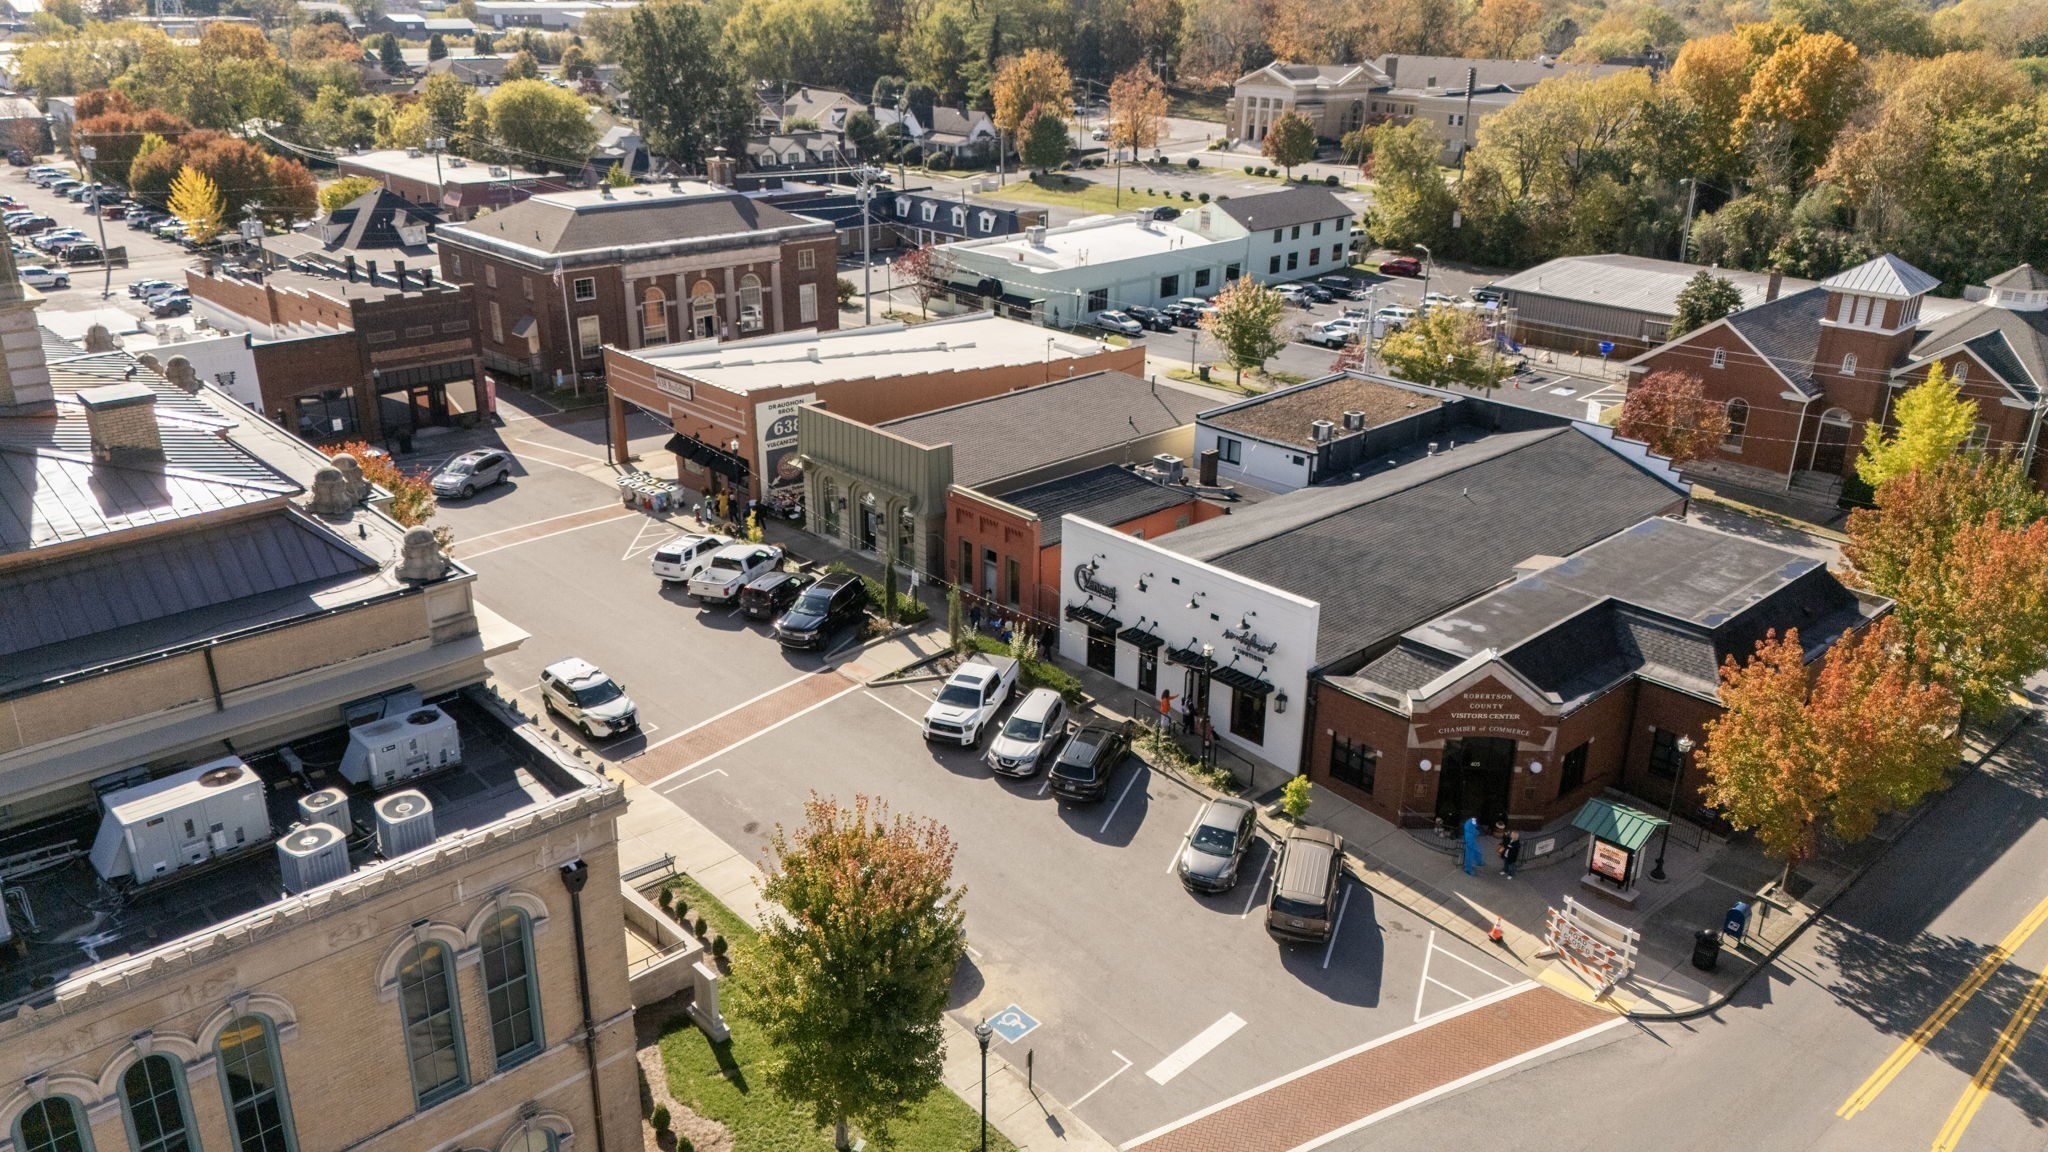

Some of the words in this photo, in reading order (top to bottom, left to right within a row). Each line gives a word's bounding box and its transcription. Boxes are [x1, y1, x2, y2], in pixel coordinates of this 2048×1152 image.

[768, 399, 805, 411] DRAUGHON
[767, 438, 799, 448] VULCANIZIN
[1439, 726, 1476, 734] CHAMBER
[1489, 726, 1530, 736] COMMERCE
[1563, 933, 1590, 954] CLOSED
[1568, 930, 1587, 945] ROAD
